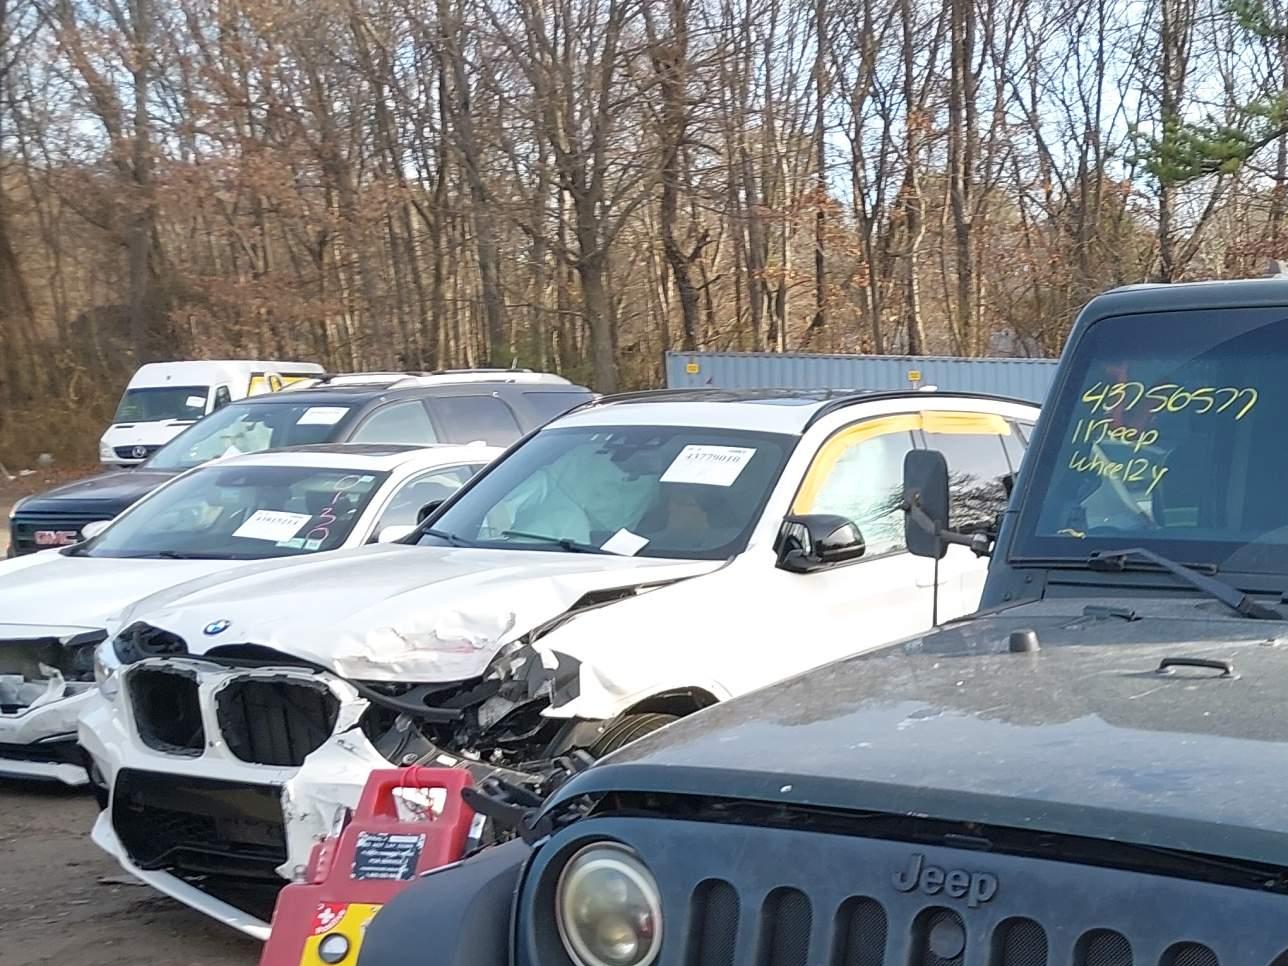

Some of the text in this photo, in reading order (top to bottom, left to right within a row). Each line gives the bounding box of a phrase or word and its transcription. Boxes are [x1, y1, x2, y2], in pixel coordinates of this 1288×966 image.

[1081, 381, 1259, 421] 43756577
[33, 530, 79, 546] GMC
[891, 852, 999, 909] Jeep
